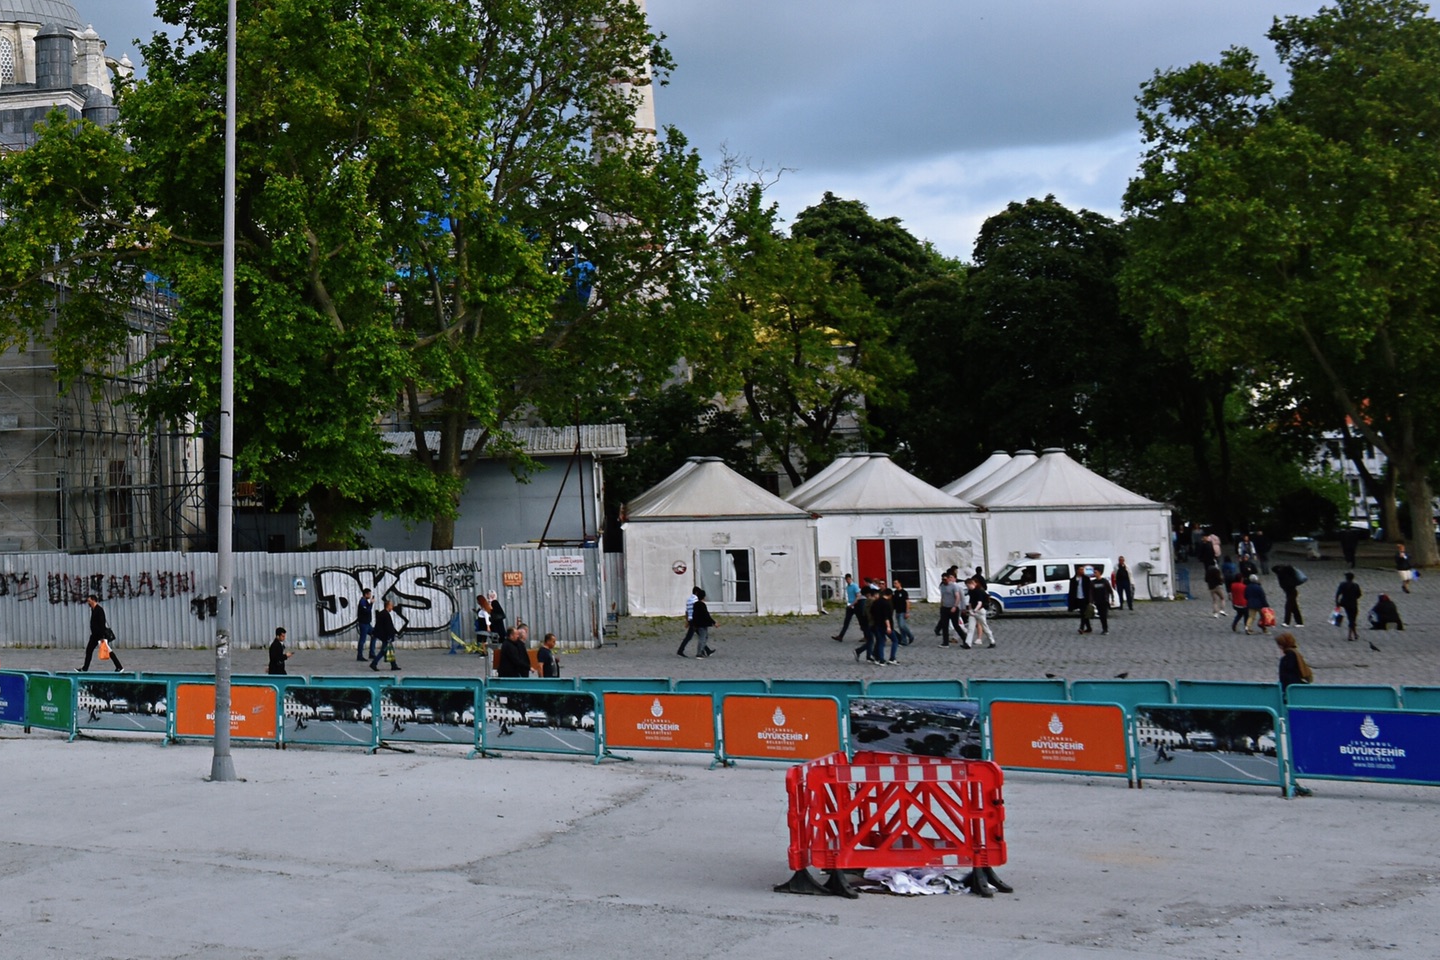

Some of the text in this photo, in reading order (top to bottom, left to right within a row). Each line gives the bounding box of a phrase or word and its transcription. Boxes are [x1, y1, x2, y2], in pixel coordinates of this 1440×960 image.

[1009, 586, 1035, 596] POLİS
[206, 713, 246, 721] BÜEHİR
[1031, 739, 1085, 751] BÜYÜKŞEHİR
[1339, 744, 1406, 757] BÜYÜKŞEHİR
